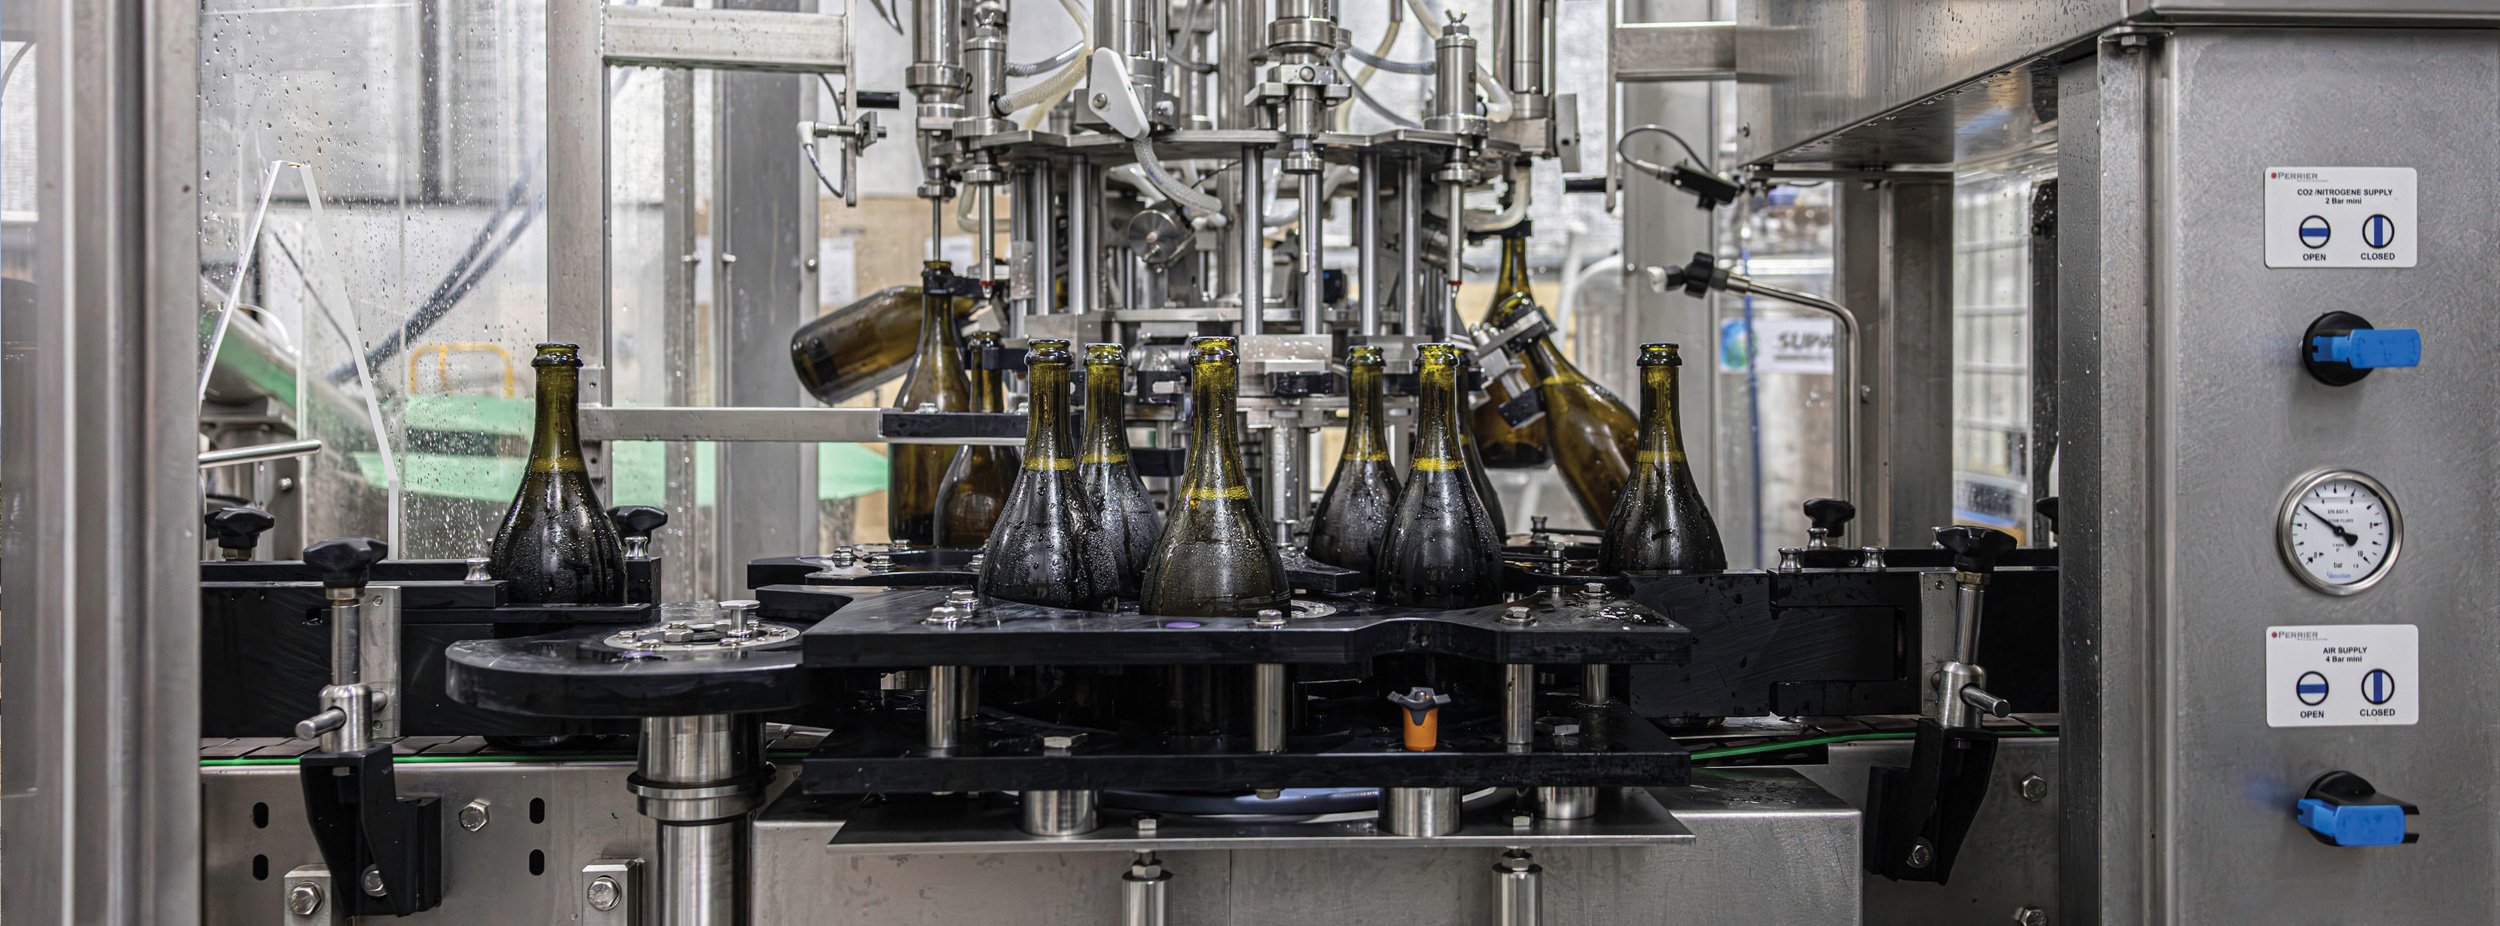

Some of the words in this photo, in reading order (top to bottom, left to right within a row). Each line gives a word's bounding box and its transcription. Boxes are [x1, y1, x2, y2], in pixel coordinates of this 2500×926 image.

[966, 72, 974, 95] 2
[2278, 172, 2318, 180] PERRIER
[2303, 253, 2326, 261] OPEN
[2278, 631, 2318, 639] PERRIER
